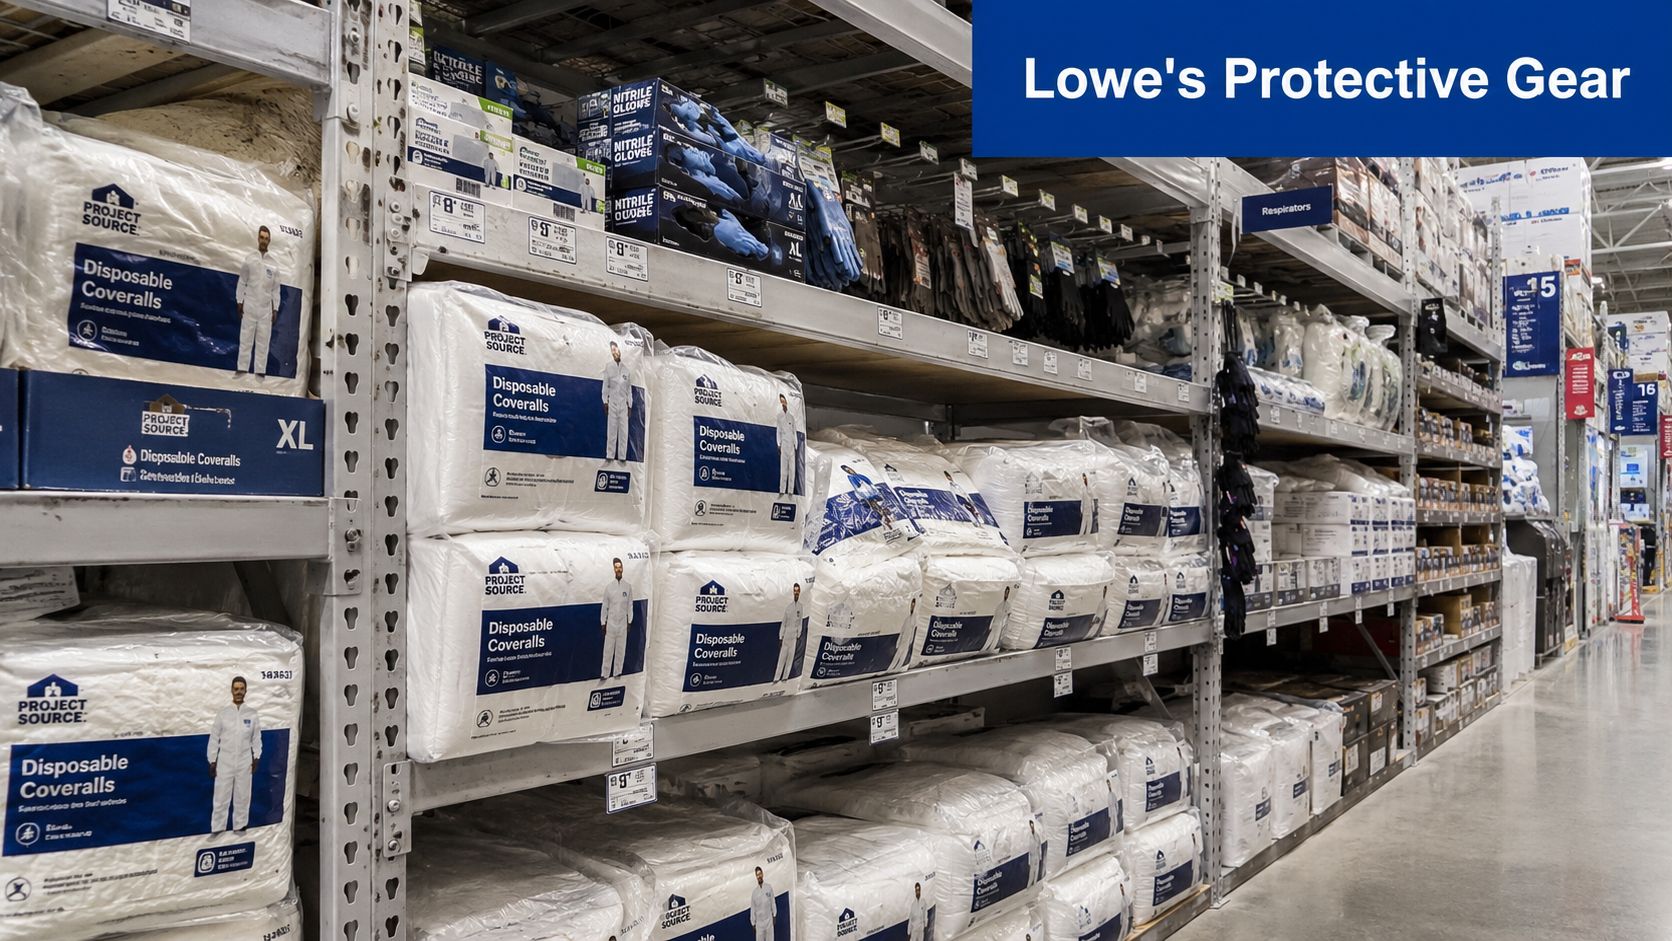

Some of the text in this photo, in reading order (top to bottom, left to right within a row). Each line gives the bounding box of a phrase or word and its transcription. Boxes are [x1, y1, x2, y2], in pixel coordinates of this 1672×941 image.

[613, 86, 653, 104] NITRILE
[614, 135, 654, 153] NITRILE
[615, 193, 654, 210] NITRILE
[1262, 203, 1312, 216] Respirators
[82, 201, 142, 223] PROJECT
[83, 258, 174, 291] Disposable
[81, 280, 163, 310] Coveralls
[484, 331, 526, 346] PROJECT
[493, 376, 556, 398] Disposable
[493, 394, 550, 414] Coveralls
[144, 414, 188, 427] PROJECT
[276, 418, 314, 450] XL
[700, 440, 740, 455] Coveralls
[198, 453, 241, 467] Coveralls
[486, 575, 526, 586] PROJECT
[696, 596, 728, 604] PROJECT
[489, 618, 554, 636] Disposable
[488, 636, 546, 653] Coveralls
[696, 633, 746, 646] Disposable
[694, 646, 738, 659] Coveralls
[18, 700, 87, 714] PROJECT
[21, 754, 129, 779] Disposable
[20, 776, 116, 800] Coveralls
[662, 913, 691, 930] SOURCE
